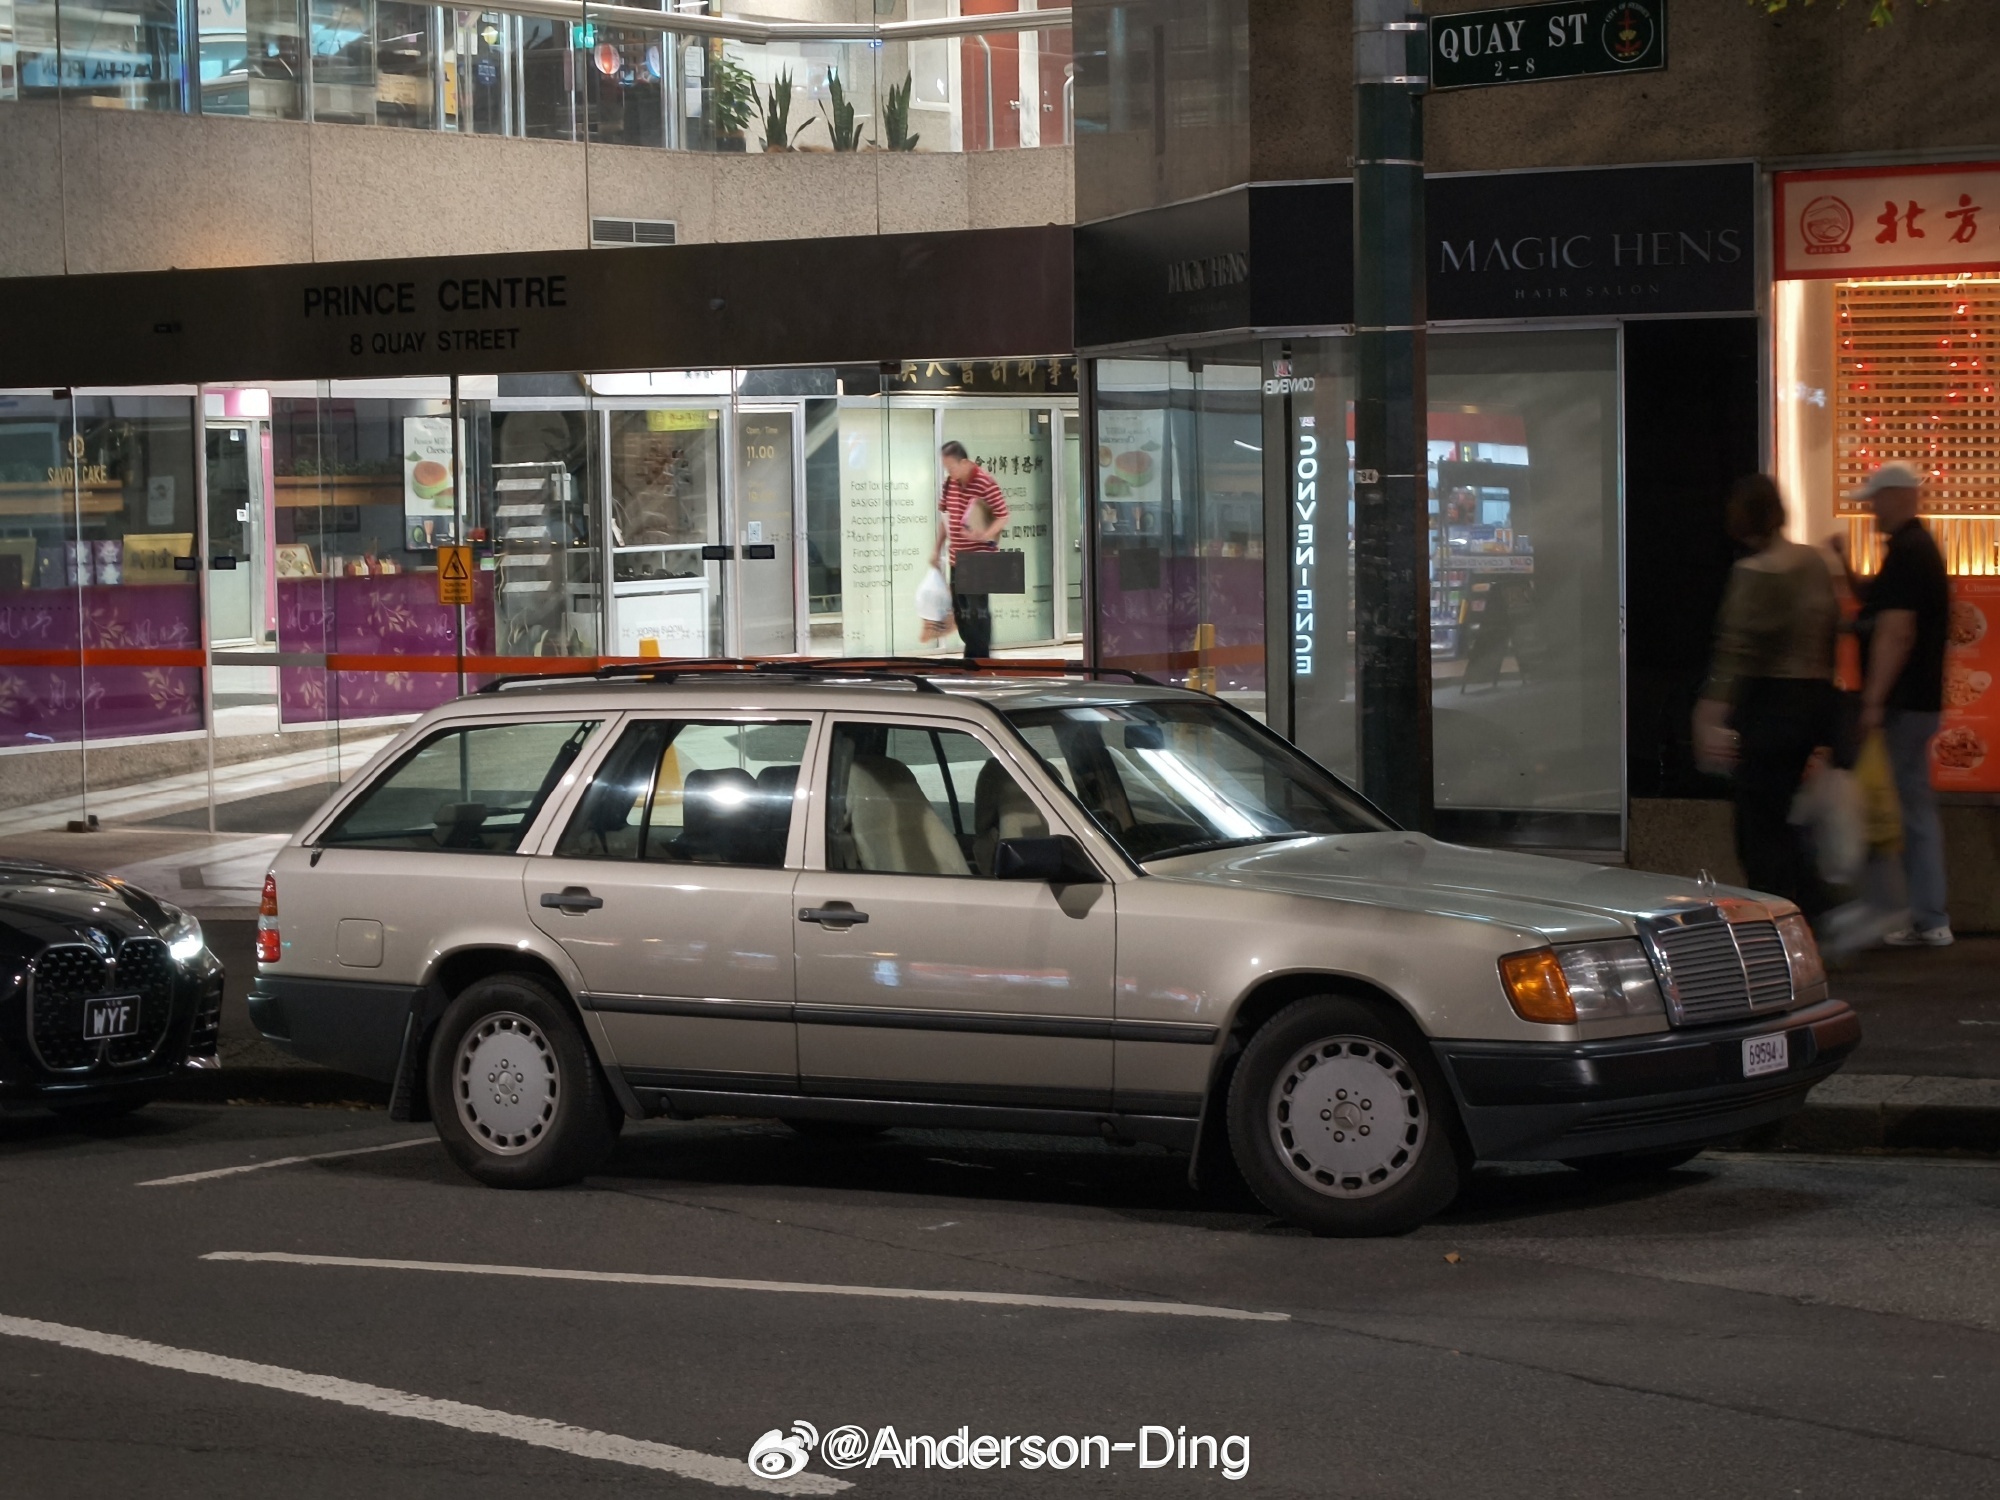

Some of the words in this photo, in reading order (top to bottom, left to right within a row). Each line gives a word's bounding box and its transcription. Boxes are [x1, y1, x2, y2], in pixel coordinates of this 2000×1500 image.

[1439, 20, 1526, 63] QUAY
[1548, 13, 1588, 47] ST
[1874, 192, 1983, 244] 北方
[1440, 234, 1593, 272] MAGIC
[1612, 228, 1742, 267] HENS
[304, 282, 415, 317] PRINCE
[438, 275, 567, 312] CENTRE
[1515, 287, 1568, 299] HAIR
[1586, 284, 1659, 297] SALON
[350, 333, 363, 355] 8
[371, 331, 426, 354] QUAY
[438, 327, 520, 351] STREET
[48, 466, 79, 487] SAVO
[82, 464, 107, 484] CAKE
[897, 514, 928, 524] Services
